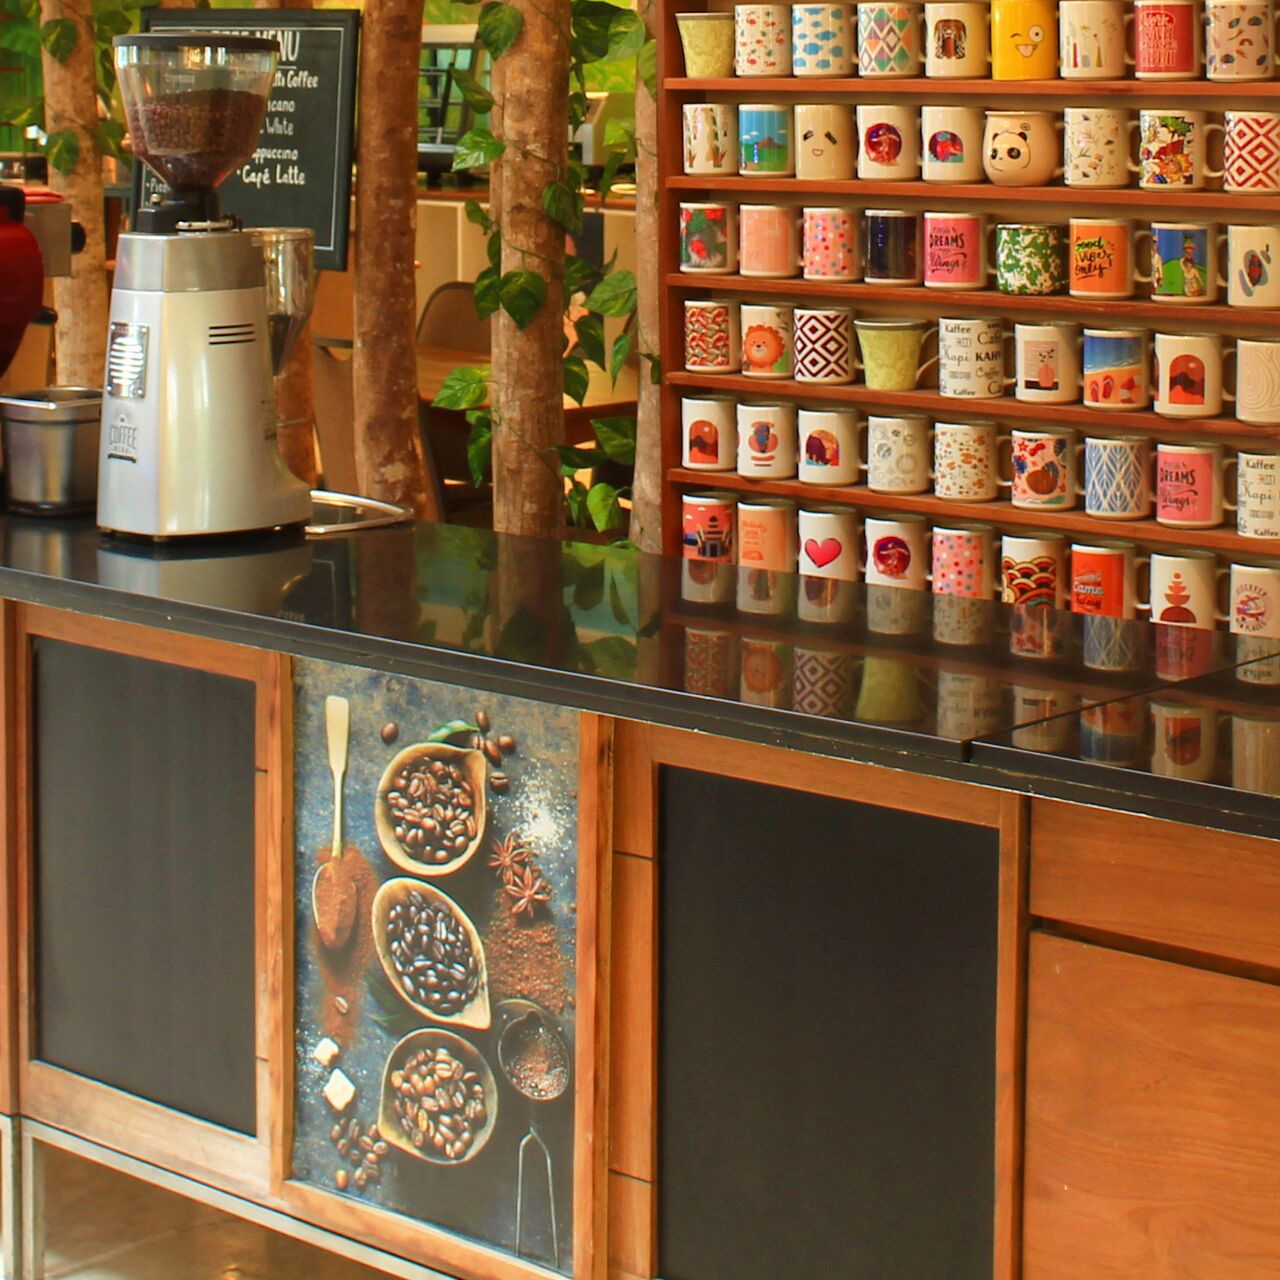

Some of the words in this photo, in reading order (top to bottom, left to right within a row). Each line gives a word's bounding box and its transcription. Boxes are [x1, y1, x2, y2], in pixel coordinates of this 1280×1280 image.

[286, 69, 319, 89] Coffee
[276, 164, 306, 185] Latte
[945, 325, 971, 334] Kaffee
[953, 389, 976, 398] Kaffee
[1246, 460, 1275, 470] Kaffee
[1254, 528, 1280, 537] Kaffee
